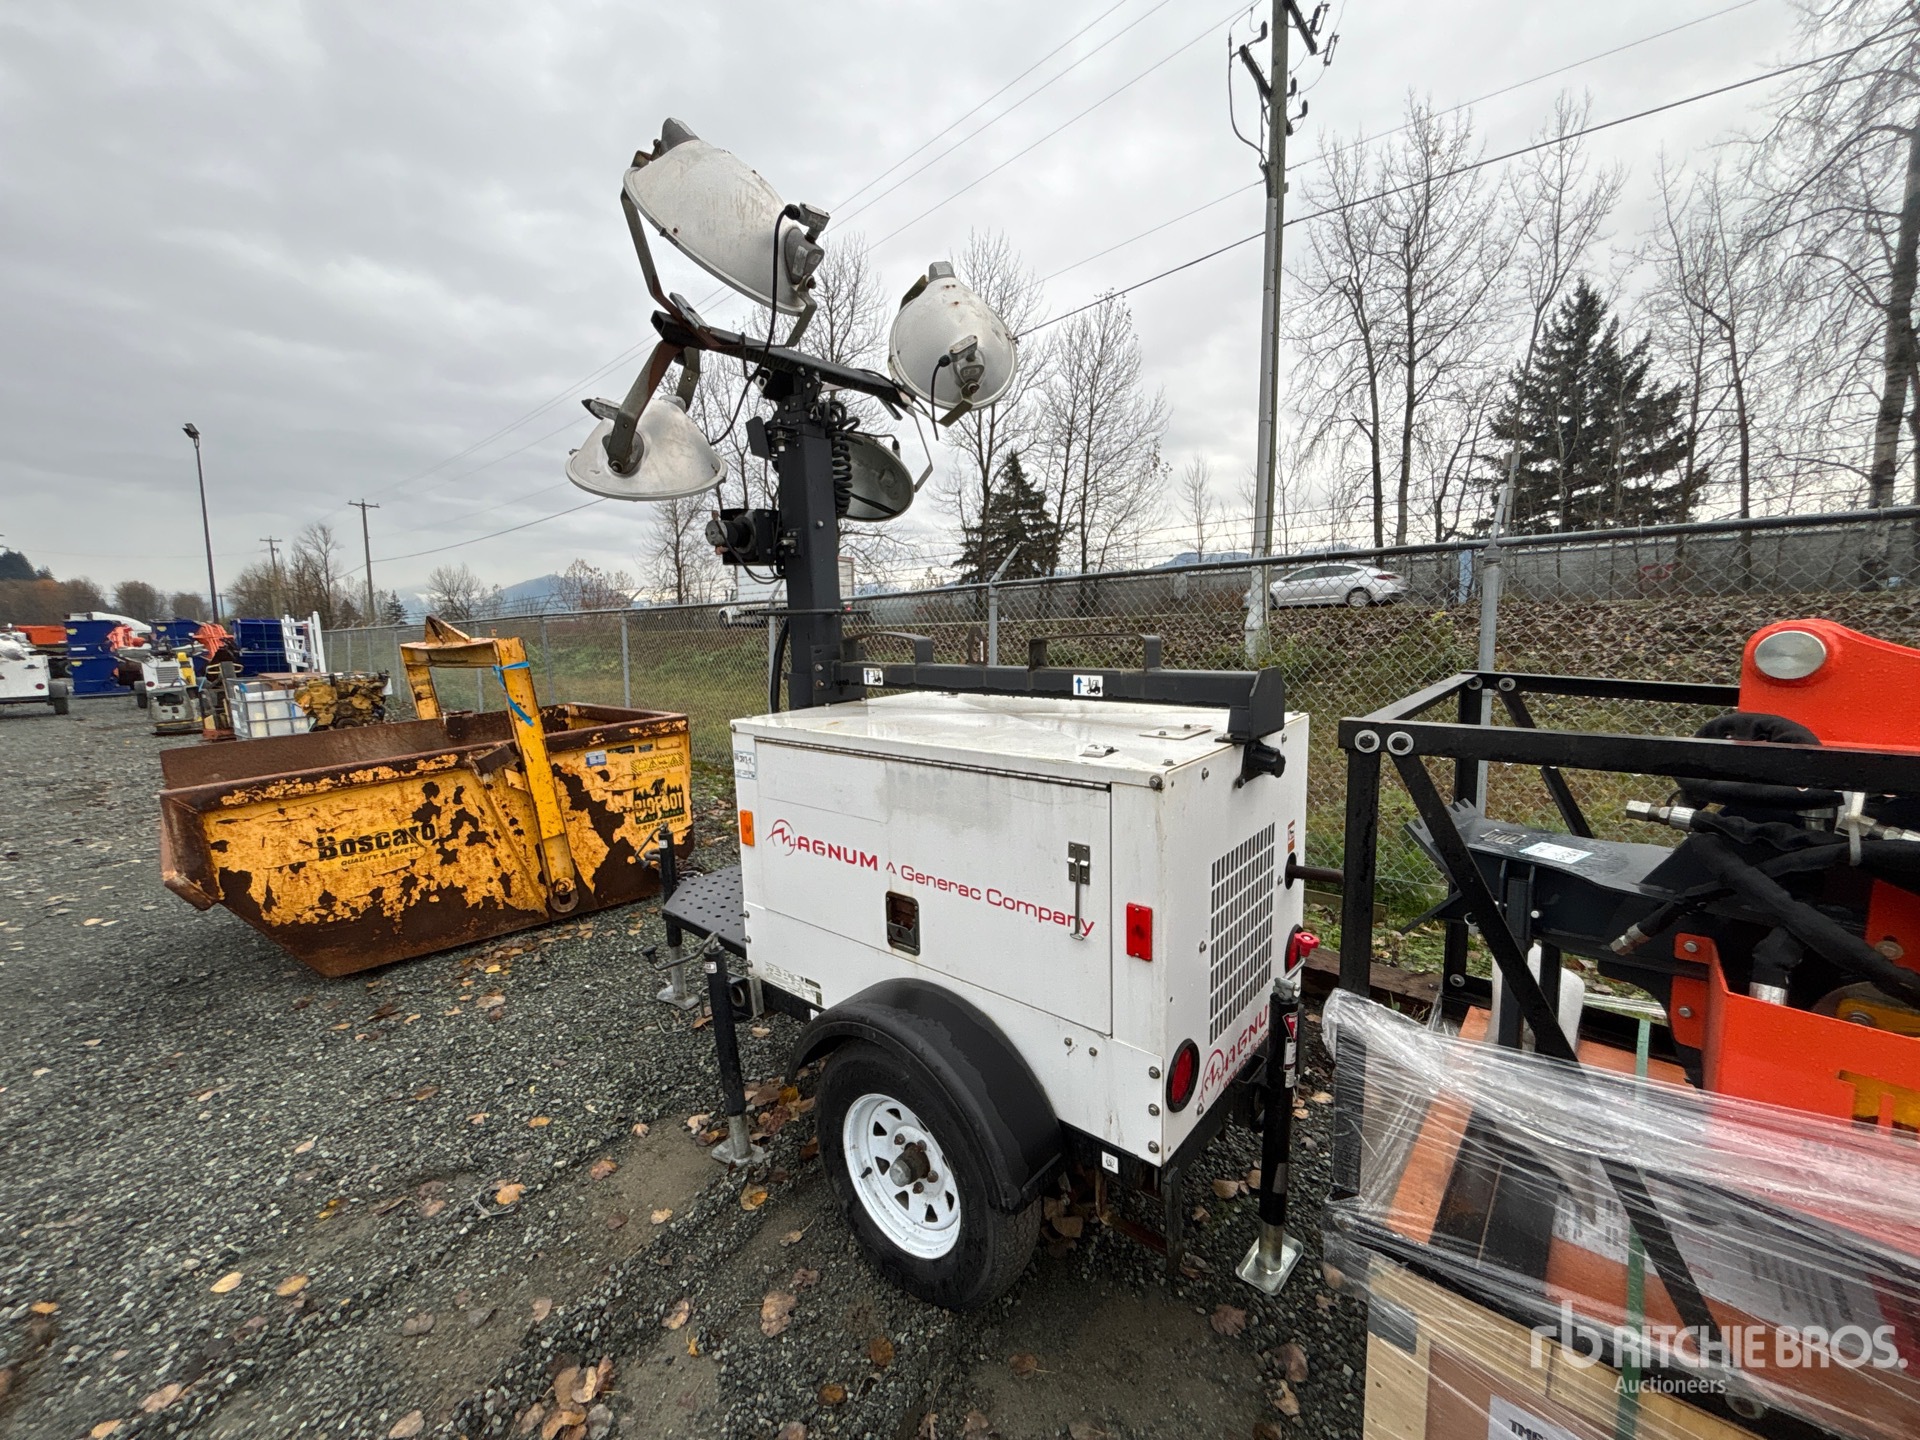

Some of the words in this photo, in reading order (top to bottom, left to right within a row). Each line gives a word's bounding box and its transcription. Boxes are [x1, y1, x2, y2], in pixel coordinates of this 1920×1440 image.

[316, 823, 436, 861] Boscaro
[341, 853, 379, 866] QUALITY
[389, 846, 420, 857] SAFETY
[766, 819, 878, 871] MAGNUM
[901, 865, 982, 900] Generac
[986, 888, 1095, 937] Company
[1198, 1004, 1269, 1103] MAGNU
